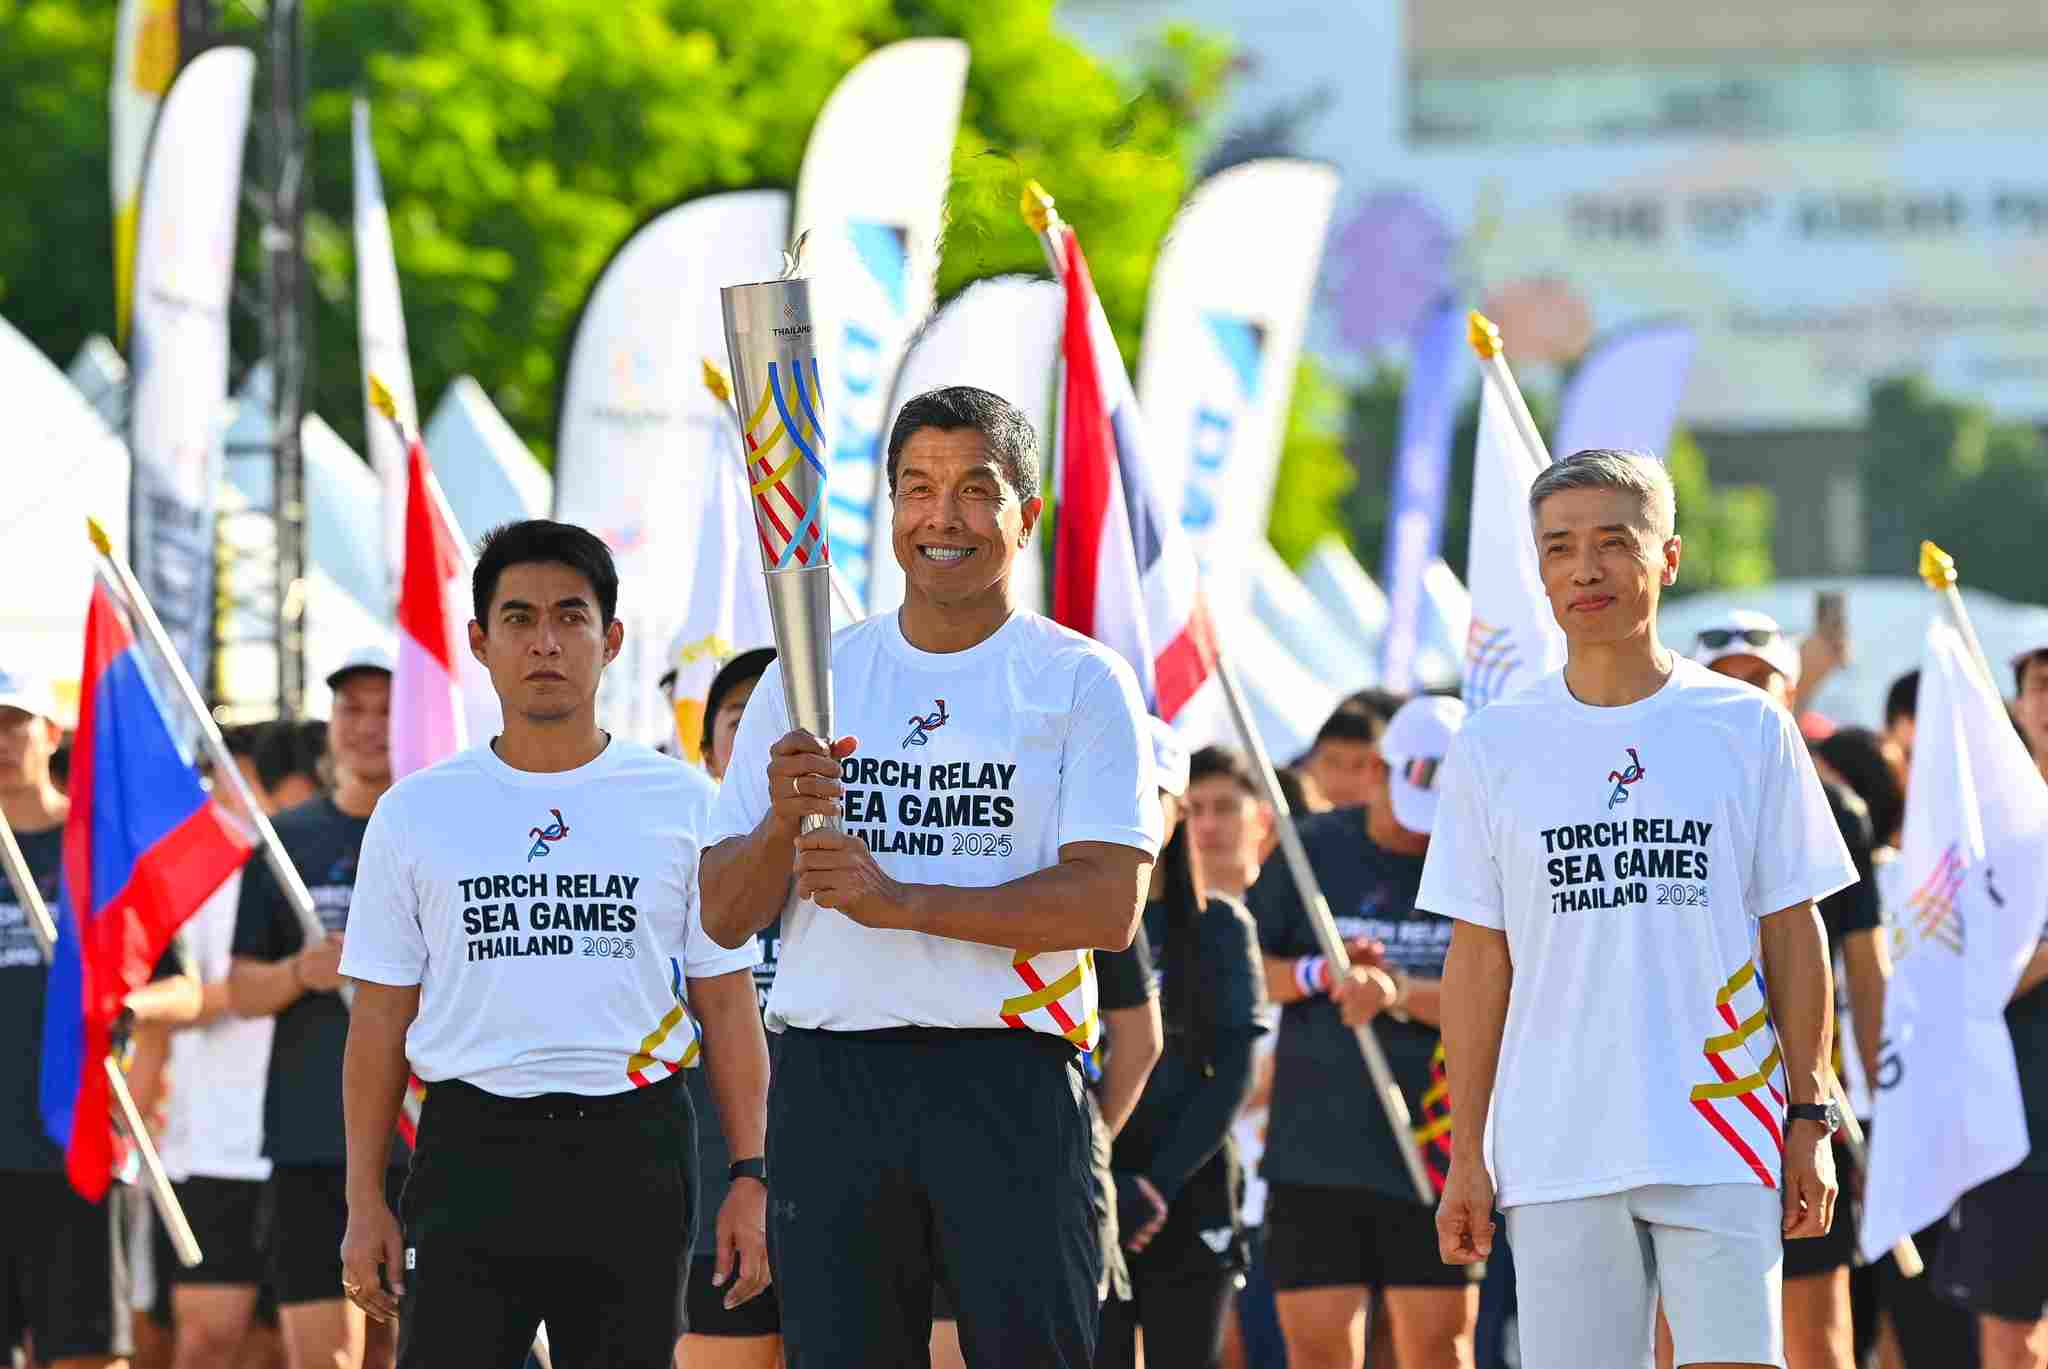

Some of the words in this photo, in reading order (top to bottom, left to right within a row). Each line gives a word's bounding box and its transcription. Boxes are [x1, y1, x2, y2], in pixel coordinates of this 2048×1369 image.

[772, 324, 812, 337] THAILAND
[841, 758, 921, 790] ORCH
[929, 762, 1016, 791] RELAY
[840, 790, 887, 823] EA
[898, 794, 1015, 827] GAMES
[951, 832, 1015, 857] 2025
[1541, 821, 1628, 853] TORCH
[1632, 818, 1713, 846] RELAY
[1547, 853, 1605, 887] SEA
[1614, 849, 1709, 880] GAMES
[458, 873, 548, 902] TORCH
[556, 874, 640, 900] RELAY
[1551, 882, 1648, 914] THAILAND
[462, 903, 520, 935] SEA
[530, 902, 637, 932] GAMES
[467, 935, 574, 961] THAILAND
[581, 936, 636, 960] 2025
